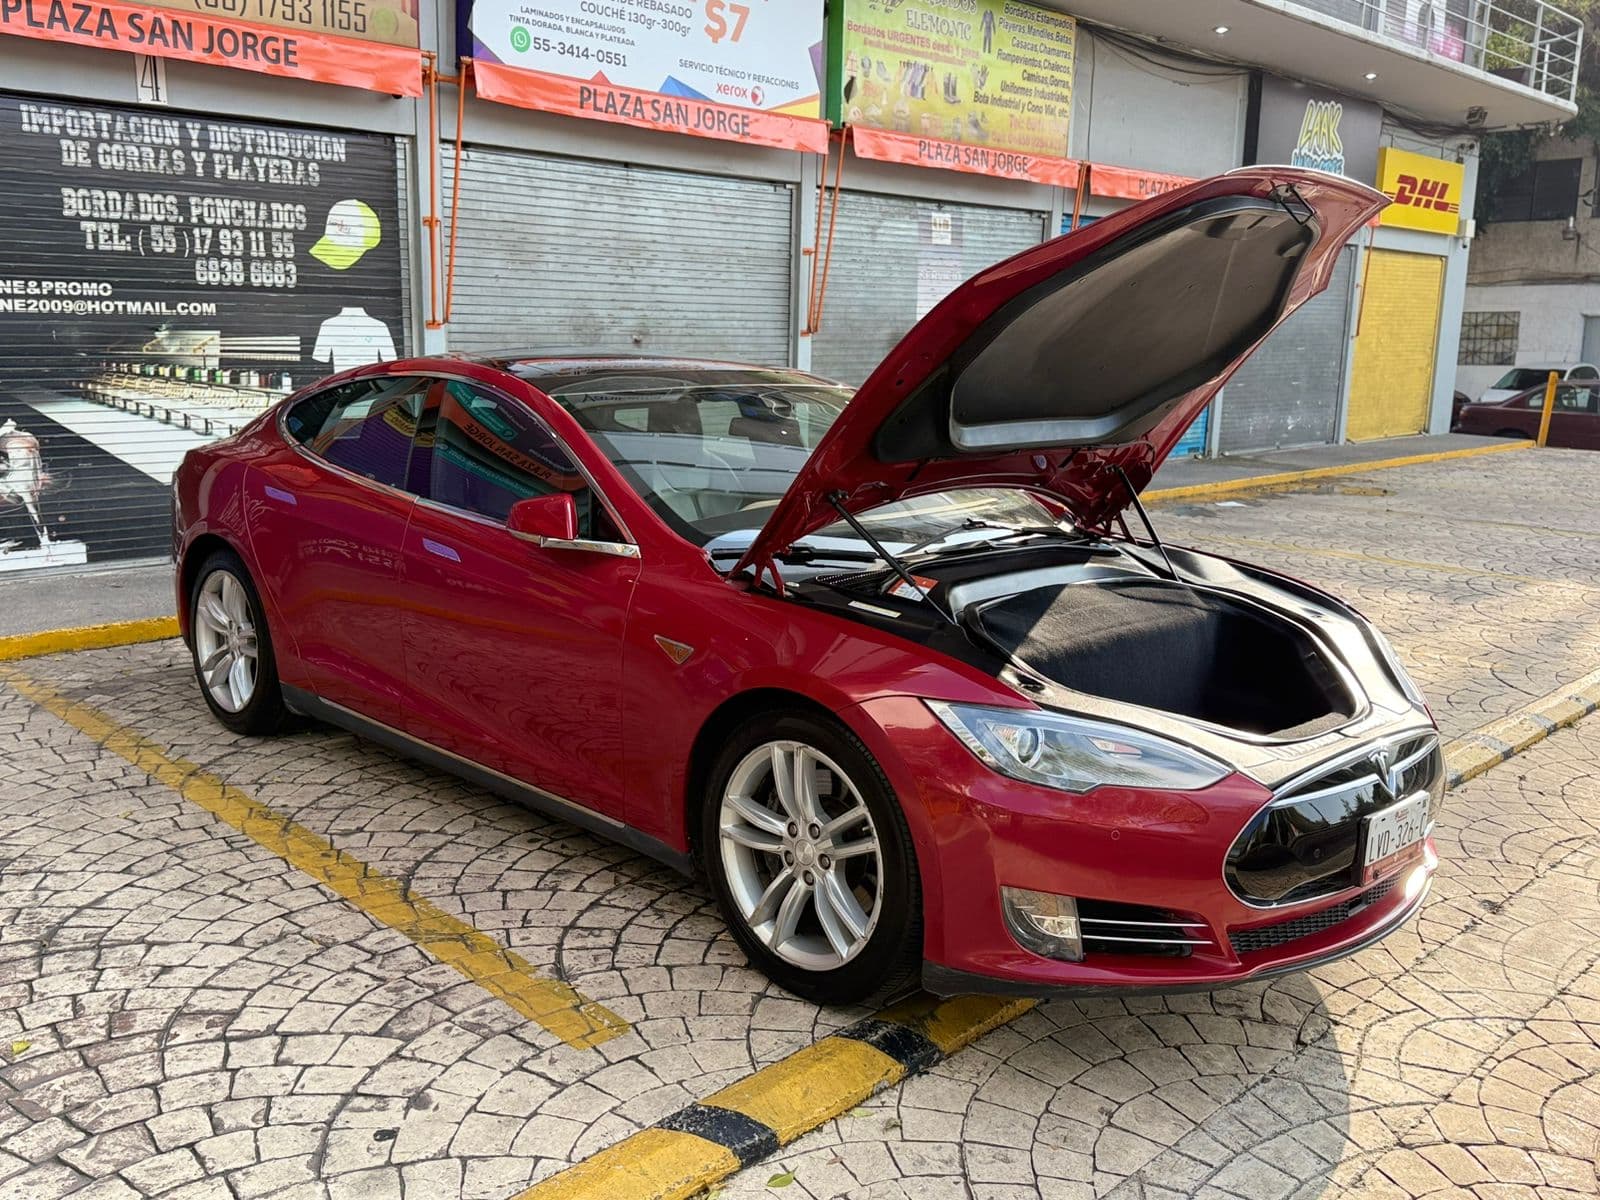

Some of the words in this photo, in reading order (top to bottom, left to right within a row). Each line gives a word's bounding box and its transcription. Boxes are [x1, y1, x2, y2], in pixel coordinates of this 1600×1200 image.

[322, 0, 366, 33] 1155
[520, 6, 565, 21] LAMINADOS
[580, 1, 626, 20] COUCHÉ
[628, 12, 691, 37] 130gr-300gr
[636, 0, 692, 18] REBASADO
[704, 0, 750, 44] $7
[1, 0, 119, 40] PLAZA
[127, 13, 193, 50] SAN
[202, 25, 298, 67] JORGE
[509, 14, 530, 25] TINTA
[566, 26, 594, 37] BLANCA
[601, 32, 635, 46] PLATEADA
[887, 30, 931, 49] URGENTES
[533, 36, 628, 67] 55-3414-0551
[141, 54, 161, 102] 4
[679, 59, 714, 73] SERVICIO
[753, 73, 799, 90] REFACCIONES
[716, 83, 748, 98] xerox
[579, 86, 645, 119] PLAZA
[651, 99, 689, 126] SAN
[694, 107, 751, 136] JORGE
[19, 104, 181, 147] IMPORTACION
[185, 121, 201, 148] Y
[207, 124, 347, 162] DISTRIBUCION
[60, 139, 92, 167] DE
[97, 142, 186, 175] GORRAS
[191, 150, 206, 176] Y
[212, 152, 321, 187] PLAYERAS
[918, 140, 961, 164] PLAZA
[964, 147, 989, 168] SAN
[992, 152, 1028, 173] JORGE
[1138, 179, 1169, 195] PLAZA
[1394, 174, 1450, 212] DHL
[189, 196, 307, 230] PONCHADOS
[80, 221, 132, 251] TEL:
[219, 229, 244, 256] 93
[249, 231, 266, 257] 11
[272, 231, 295, 258] 55
[0, 280, 113, 296] NE&PROMO
[0, 298, 217, 316] NE2009@HOTMAIL.COM
